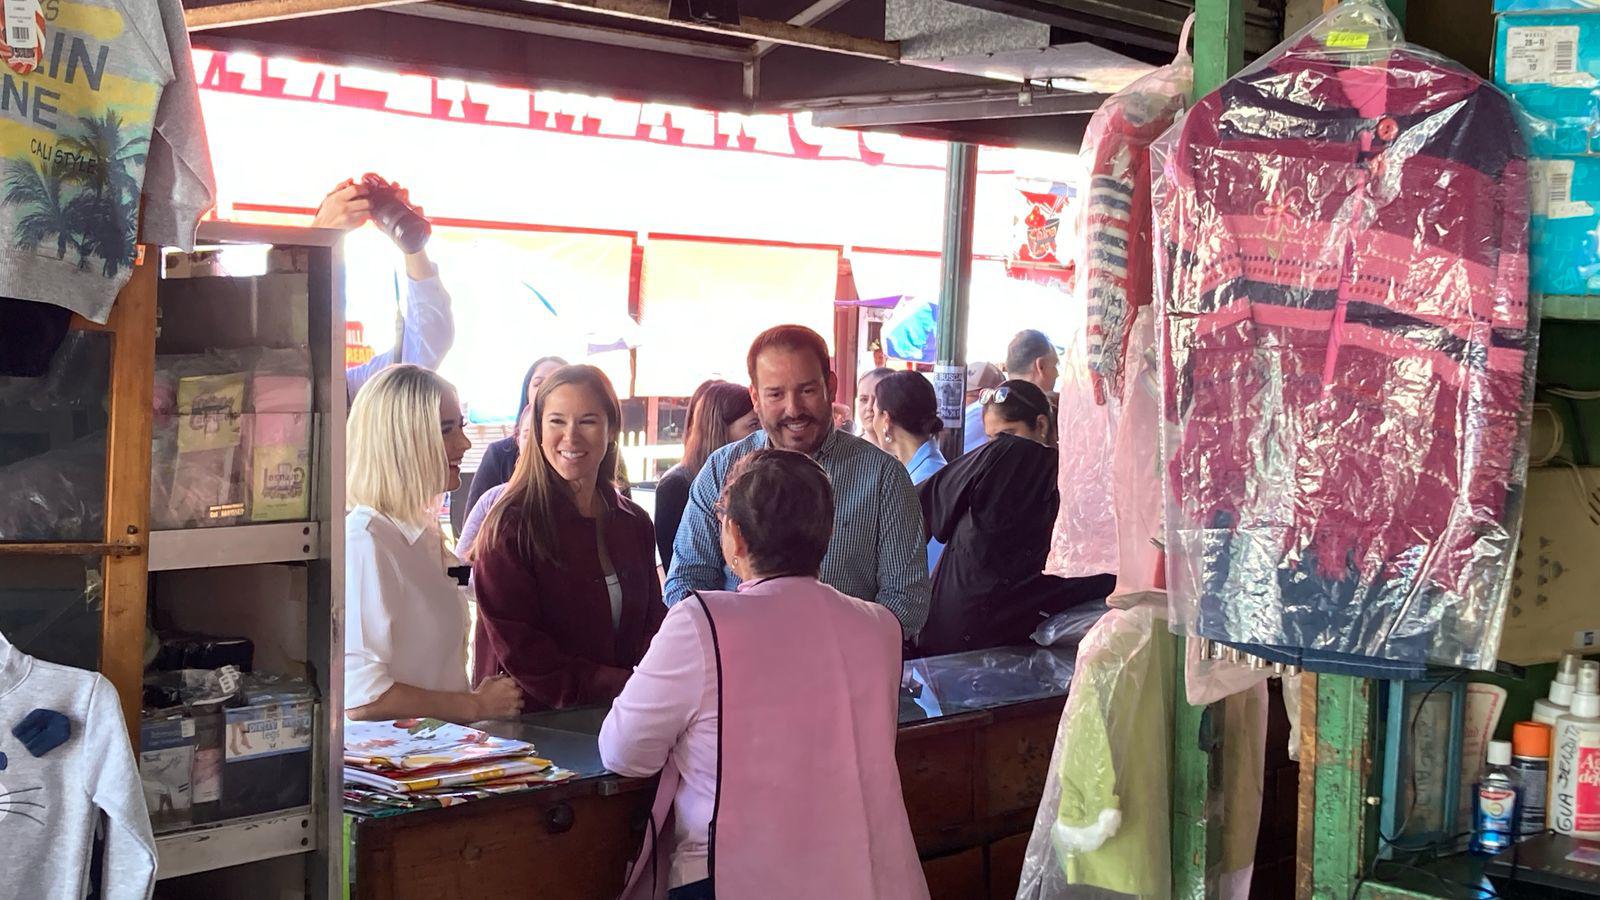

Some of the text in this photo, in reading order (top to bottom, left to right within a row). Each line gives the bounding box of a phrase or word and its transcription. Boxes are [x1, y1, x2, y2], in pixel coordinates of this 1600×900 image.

[34, 31, 110, 92] IN
[30, 138, 97, 175] CALI STYLE
